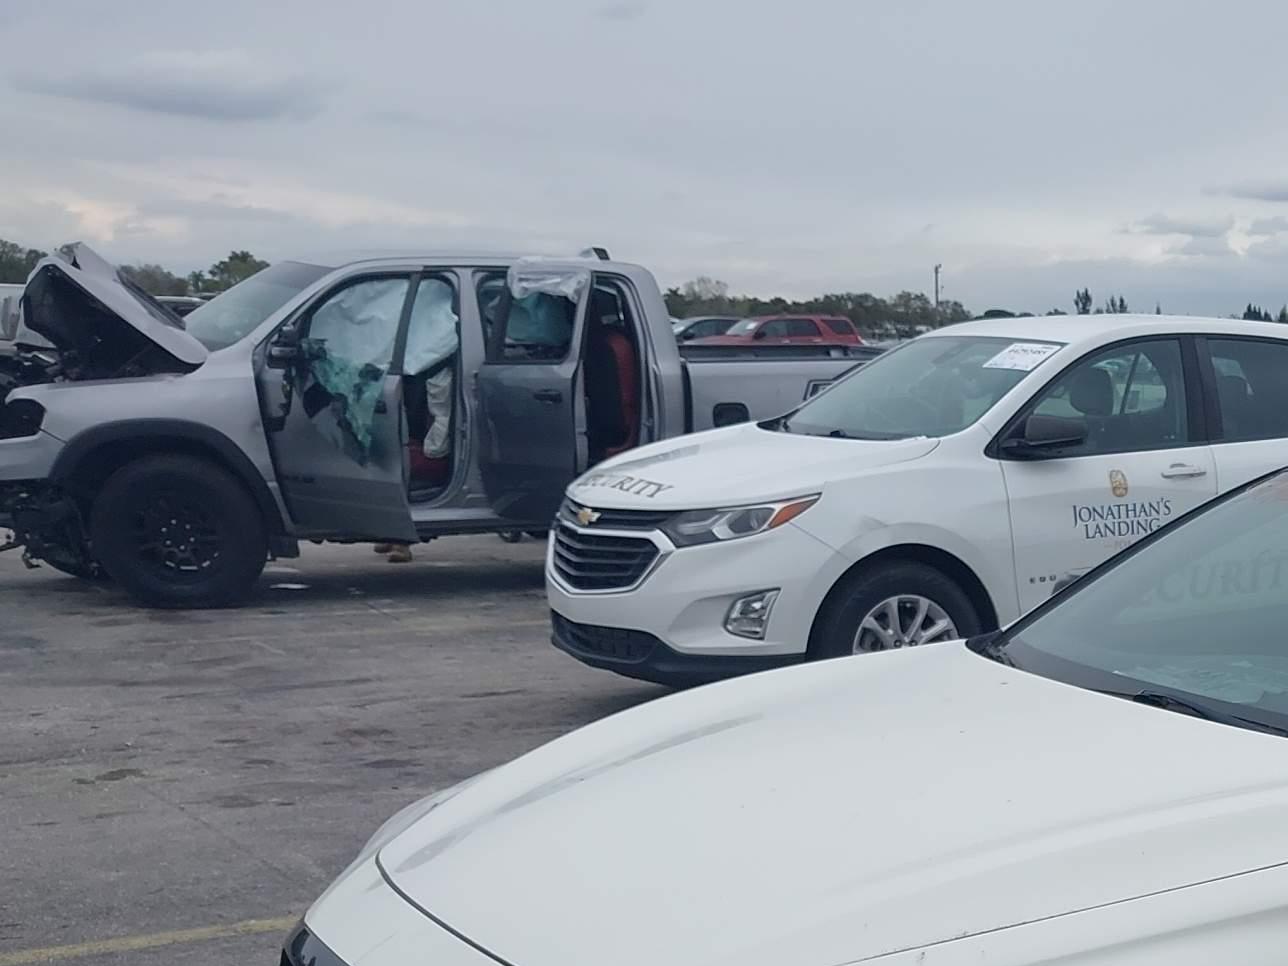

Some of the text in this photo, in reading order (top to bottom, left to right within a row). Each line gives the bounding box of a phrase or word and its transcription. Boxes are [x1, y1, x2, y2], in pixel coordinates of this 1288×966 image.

[576, 473, 675, 498] URITY
[1072, 498, 1172, 528] JONATHAN'S
[1084, 517, 1161, 540] LANDING
